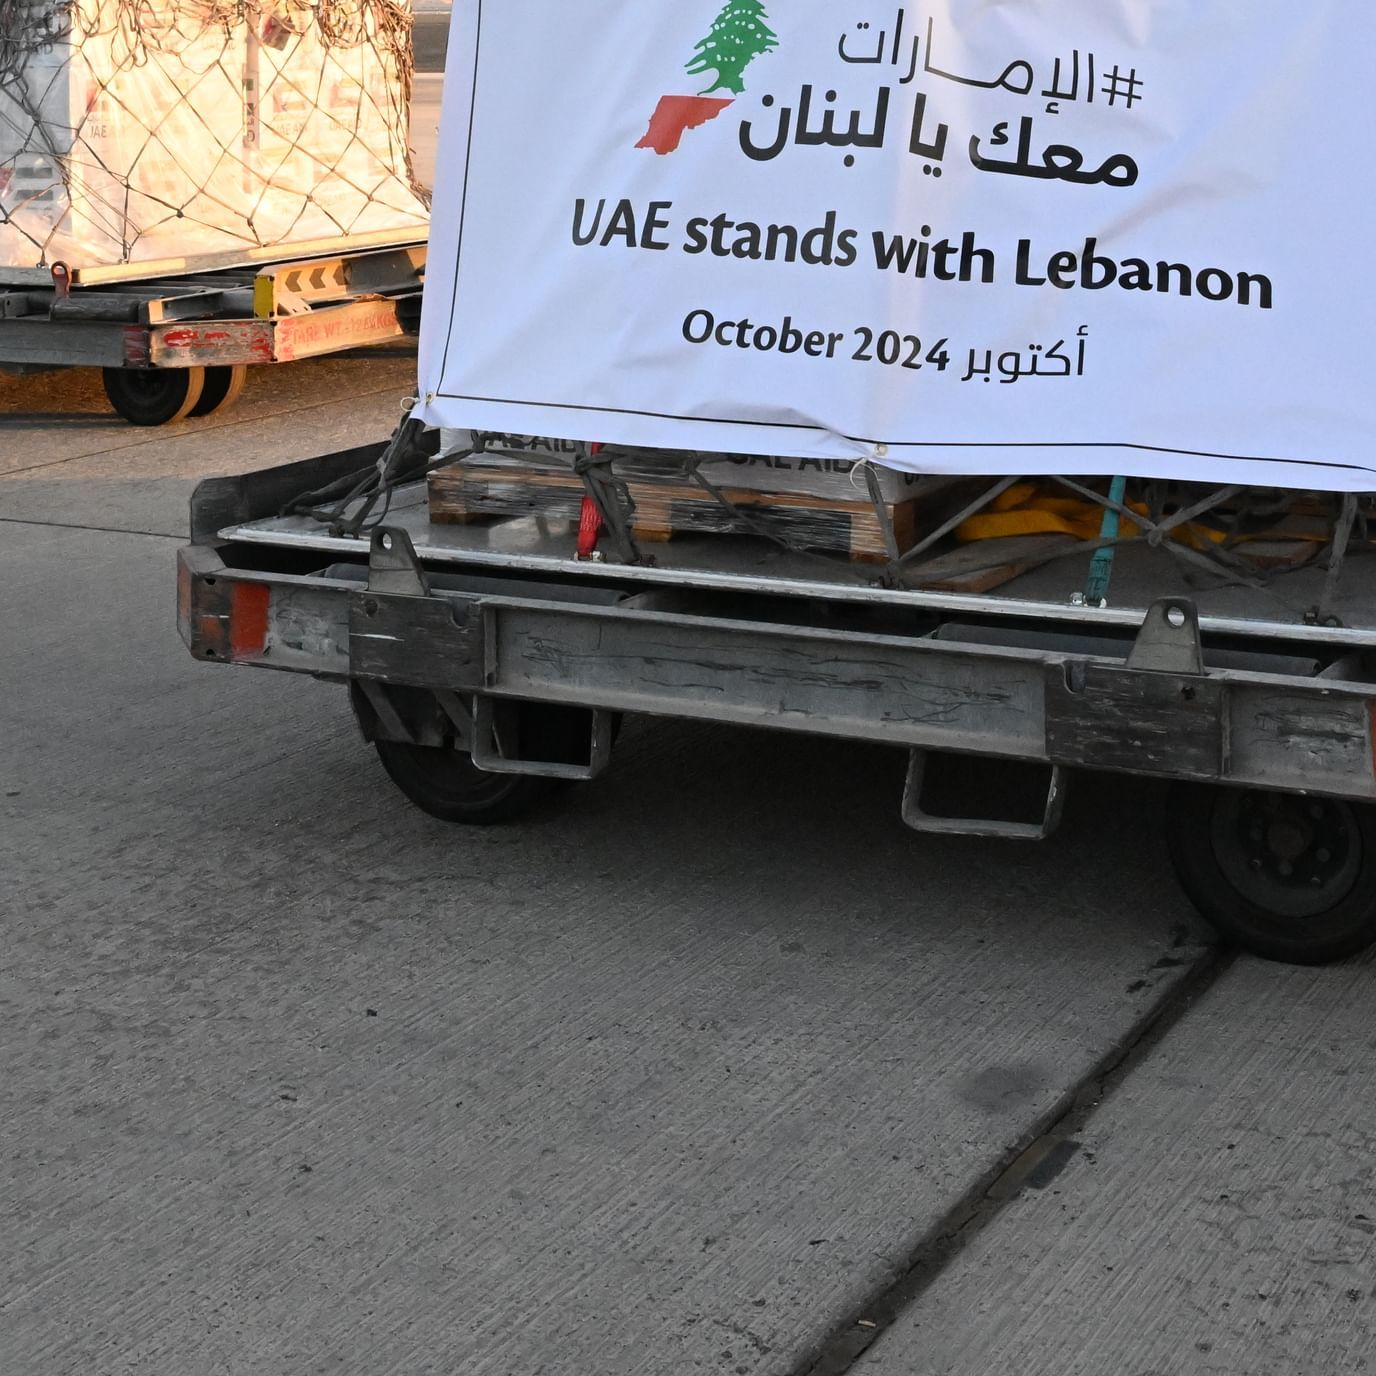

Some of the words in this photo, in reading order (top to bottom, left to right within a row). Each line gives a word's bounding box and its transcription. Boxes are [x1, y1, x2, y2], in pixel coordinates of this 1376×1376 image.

[738, 84, 891, 167] لبنان
[909, 92, 949, 178] يا
[968, 116, 1139, 187] معك
[572, 198, 673, 250] UAE
[683, 210, 858, 267] stands
[872, 224, 995, 284] with
[1015, 237, 1273, 309] Lebanon
[682, 309, 844, 358] October
[852, 326, 950, 372] 2024
[961, 324, 1089, 384] أكتوبر
